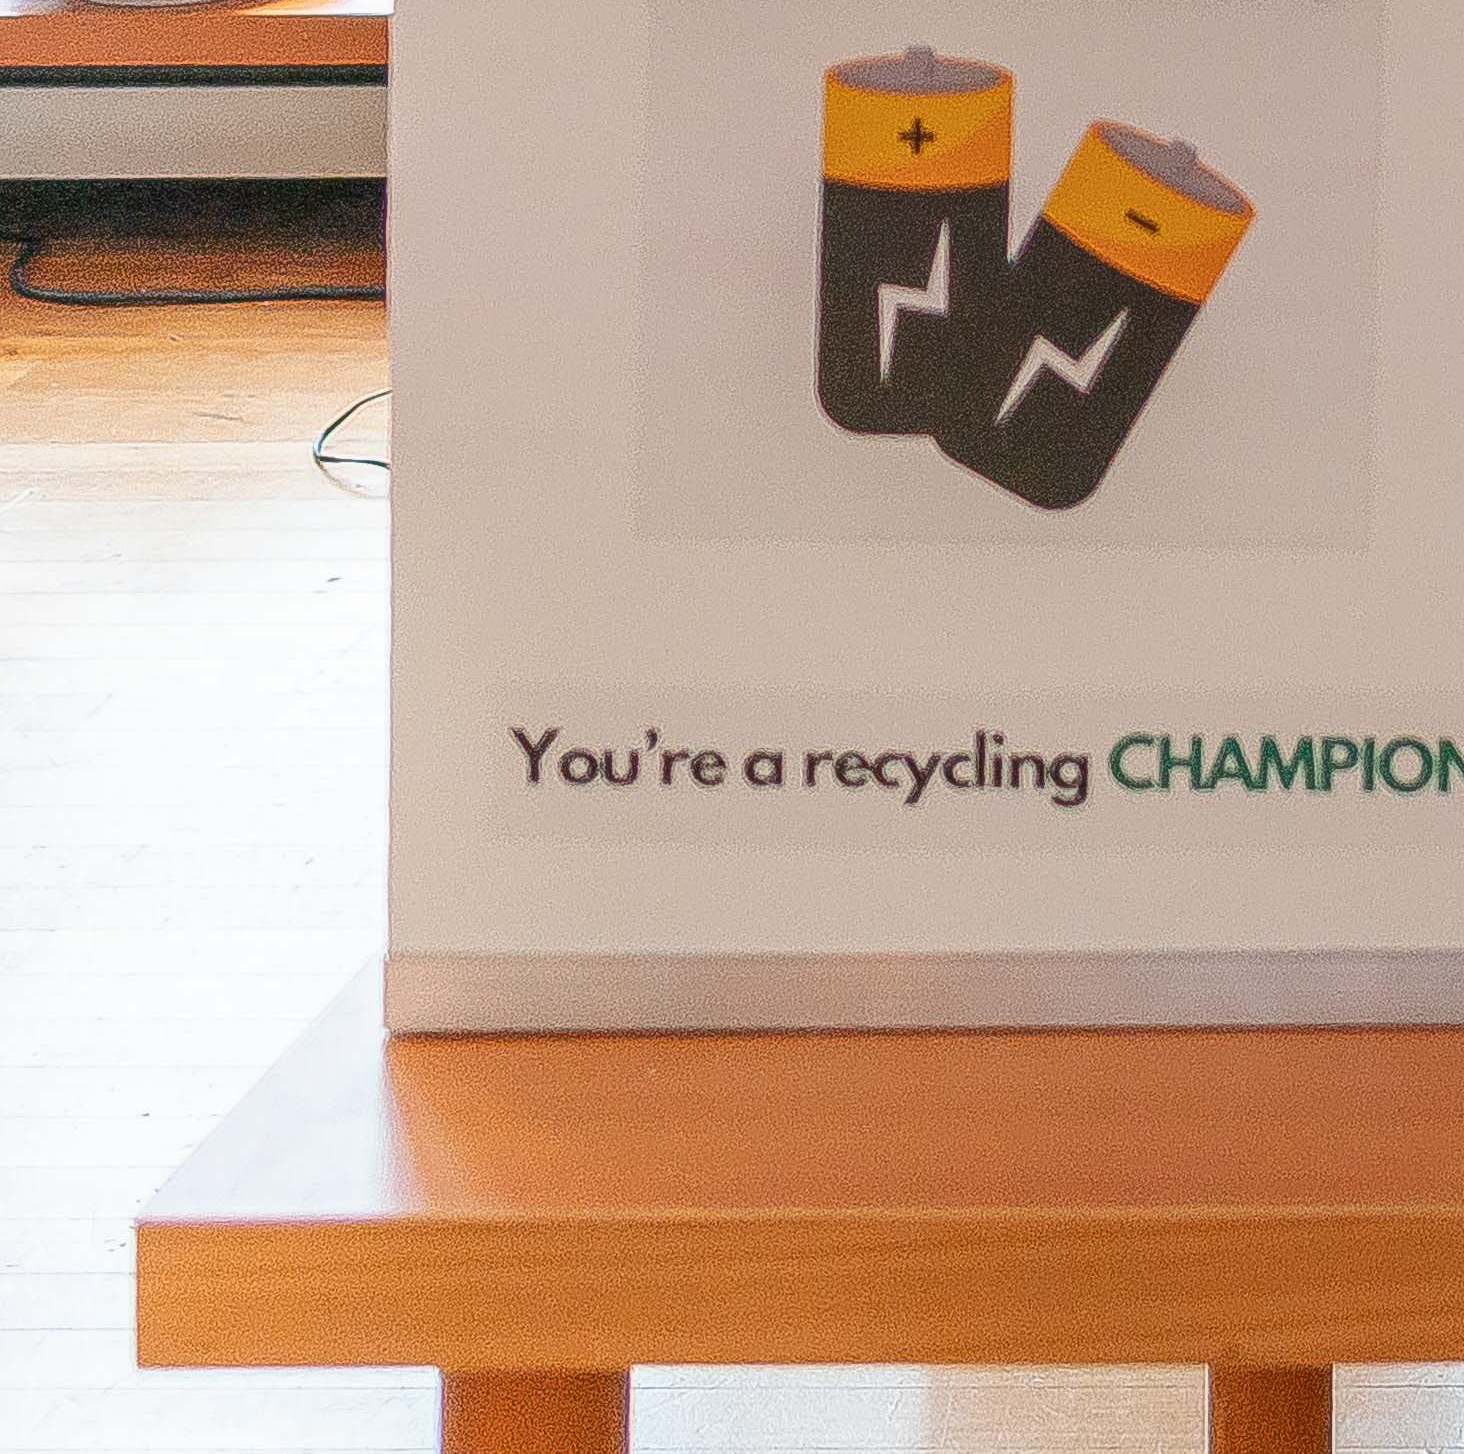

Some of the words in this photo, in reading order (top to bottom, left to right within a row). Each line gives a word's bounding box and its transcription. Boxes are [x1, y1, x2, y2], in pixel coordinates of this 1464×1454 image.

[510, 728, 726, 791] You’re
[745, 750, 783, 791] a
[803, 730, 1091, 808] recycling
